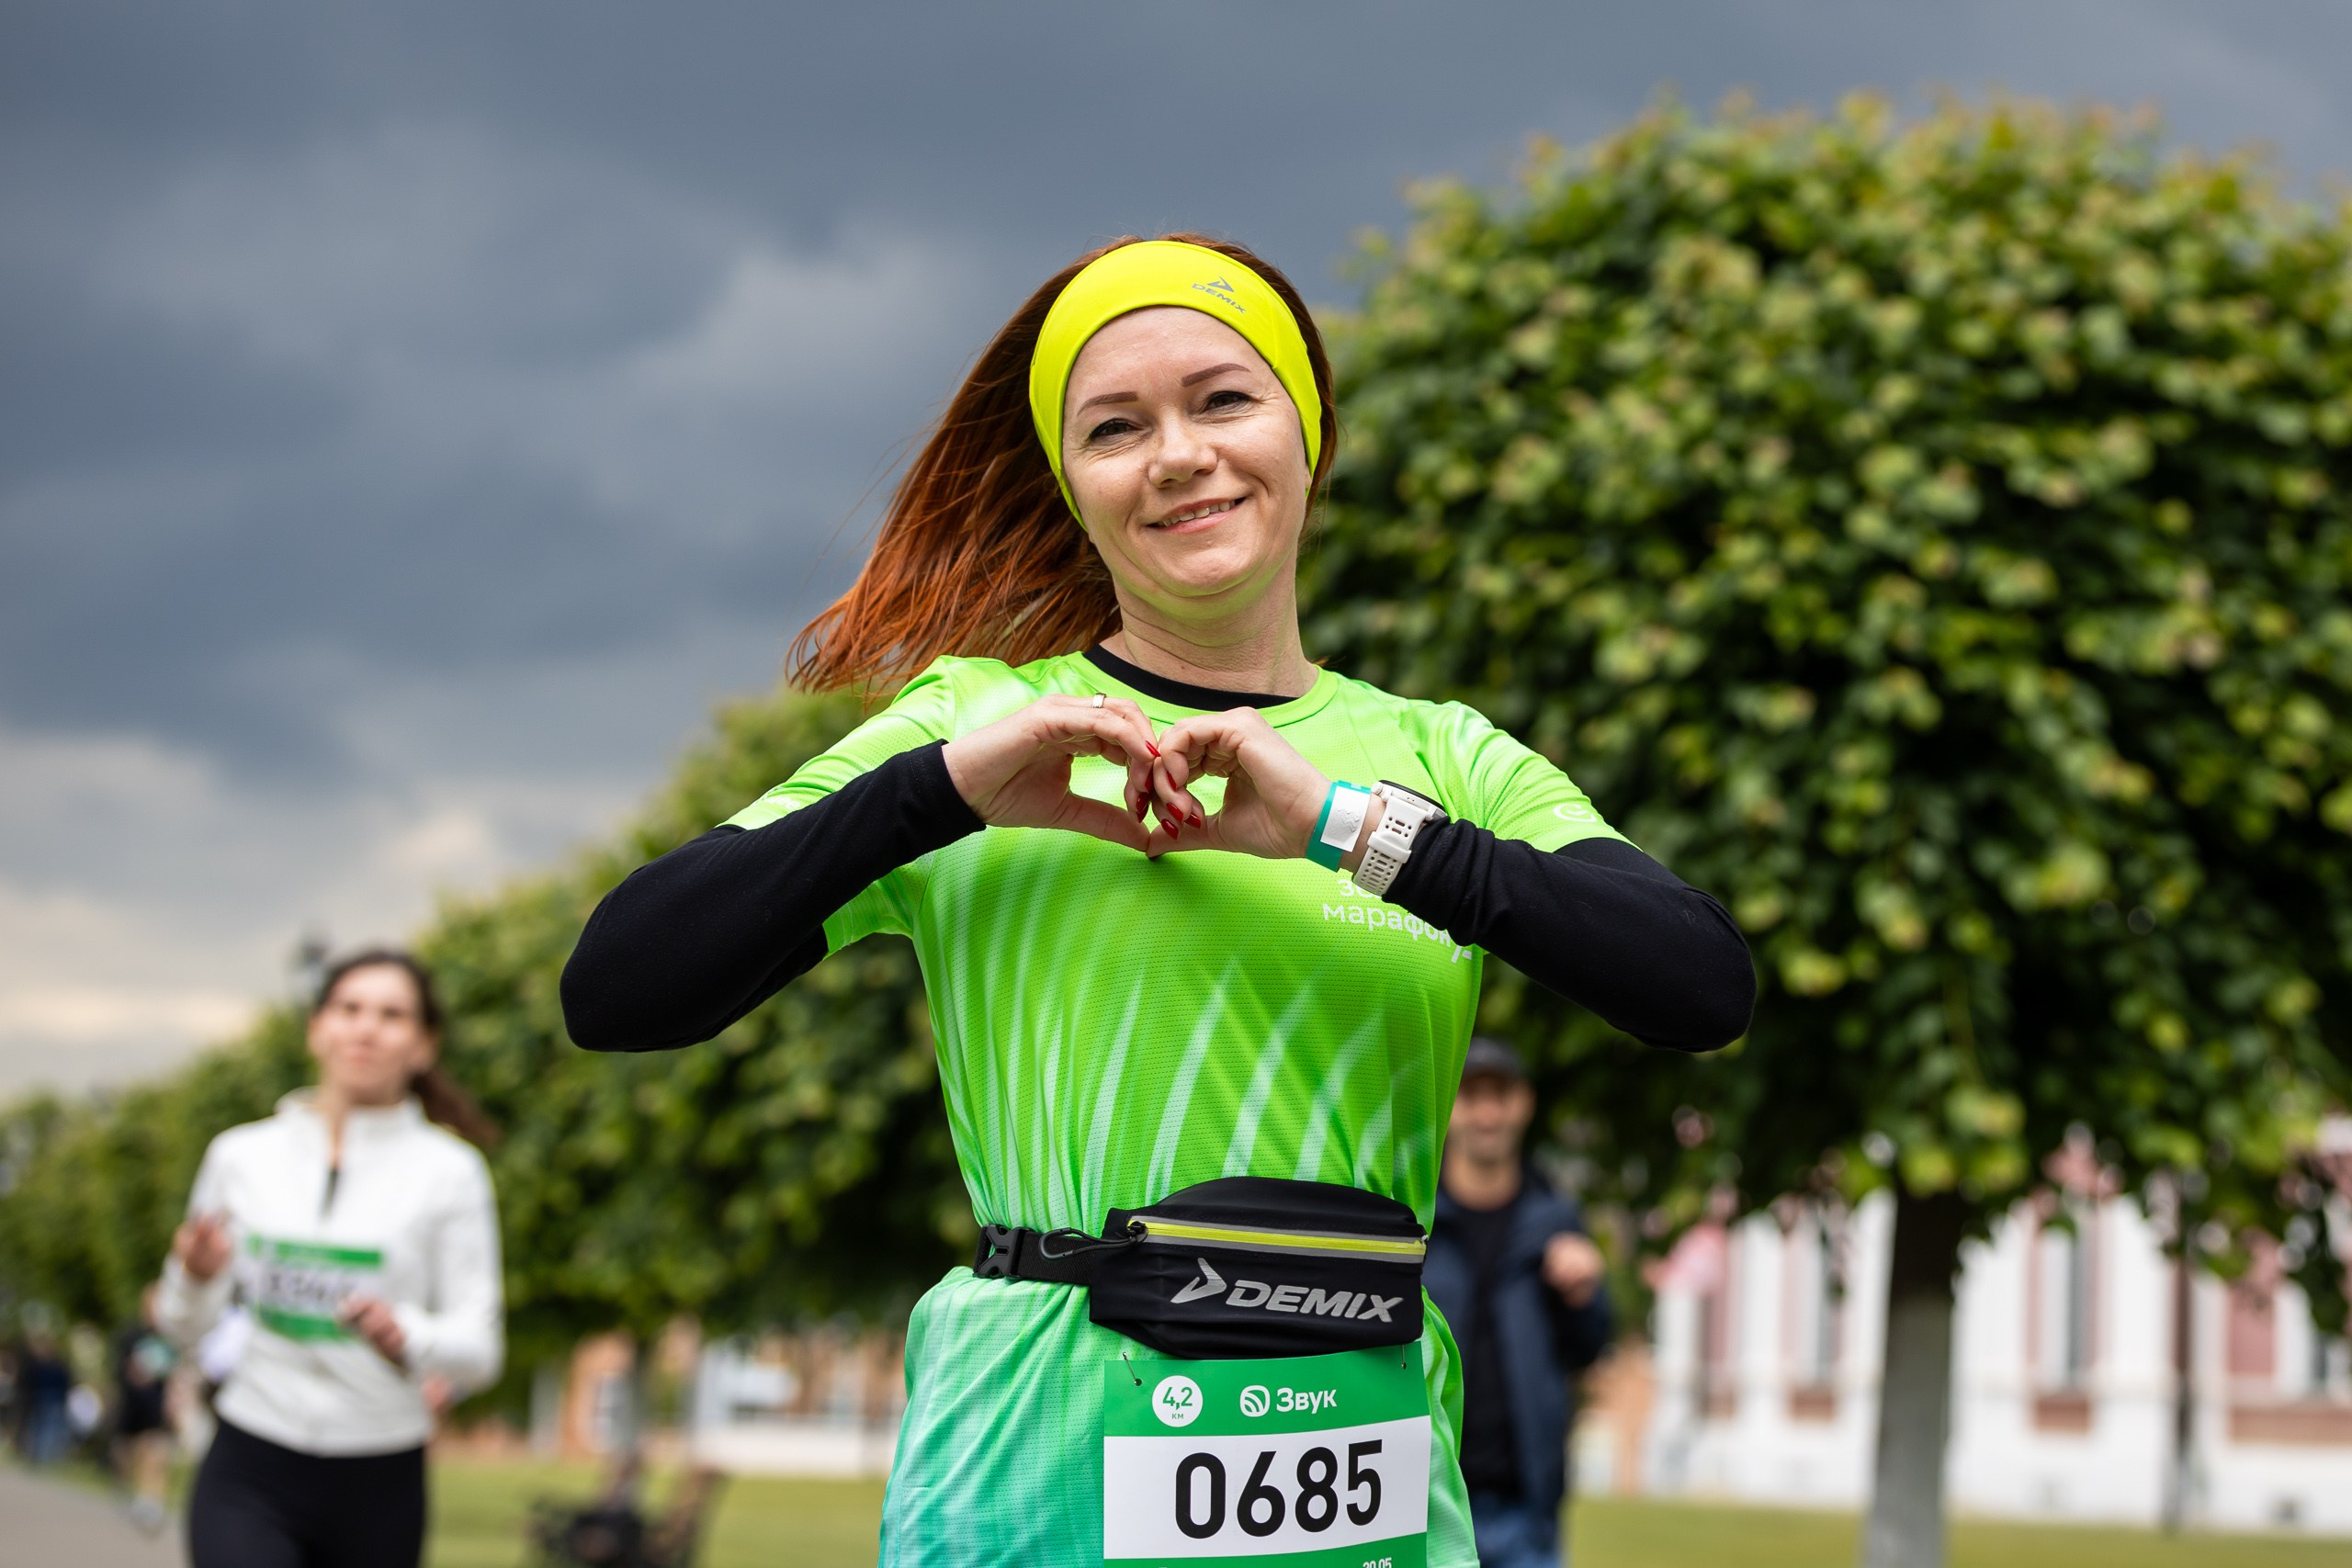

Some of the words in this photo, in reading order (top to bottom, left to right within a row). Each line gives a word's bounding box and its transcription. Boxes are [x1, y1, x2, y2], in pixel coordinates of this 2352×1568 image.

[1192, 283, 1246, 313] DEMIX
[1226, 1280, 1404, 1323] DEMIX
[1162, 1387, 1193, 1410] 4,2
[1276, 1388, 1338, 1414] Звук
[1175, 1439, 1383, 1539] 0685
